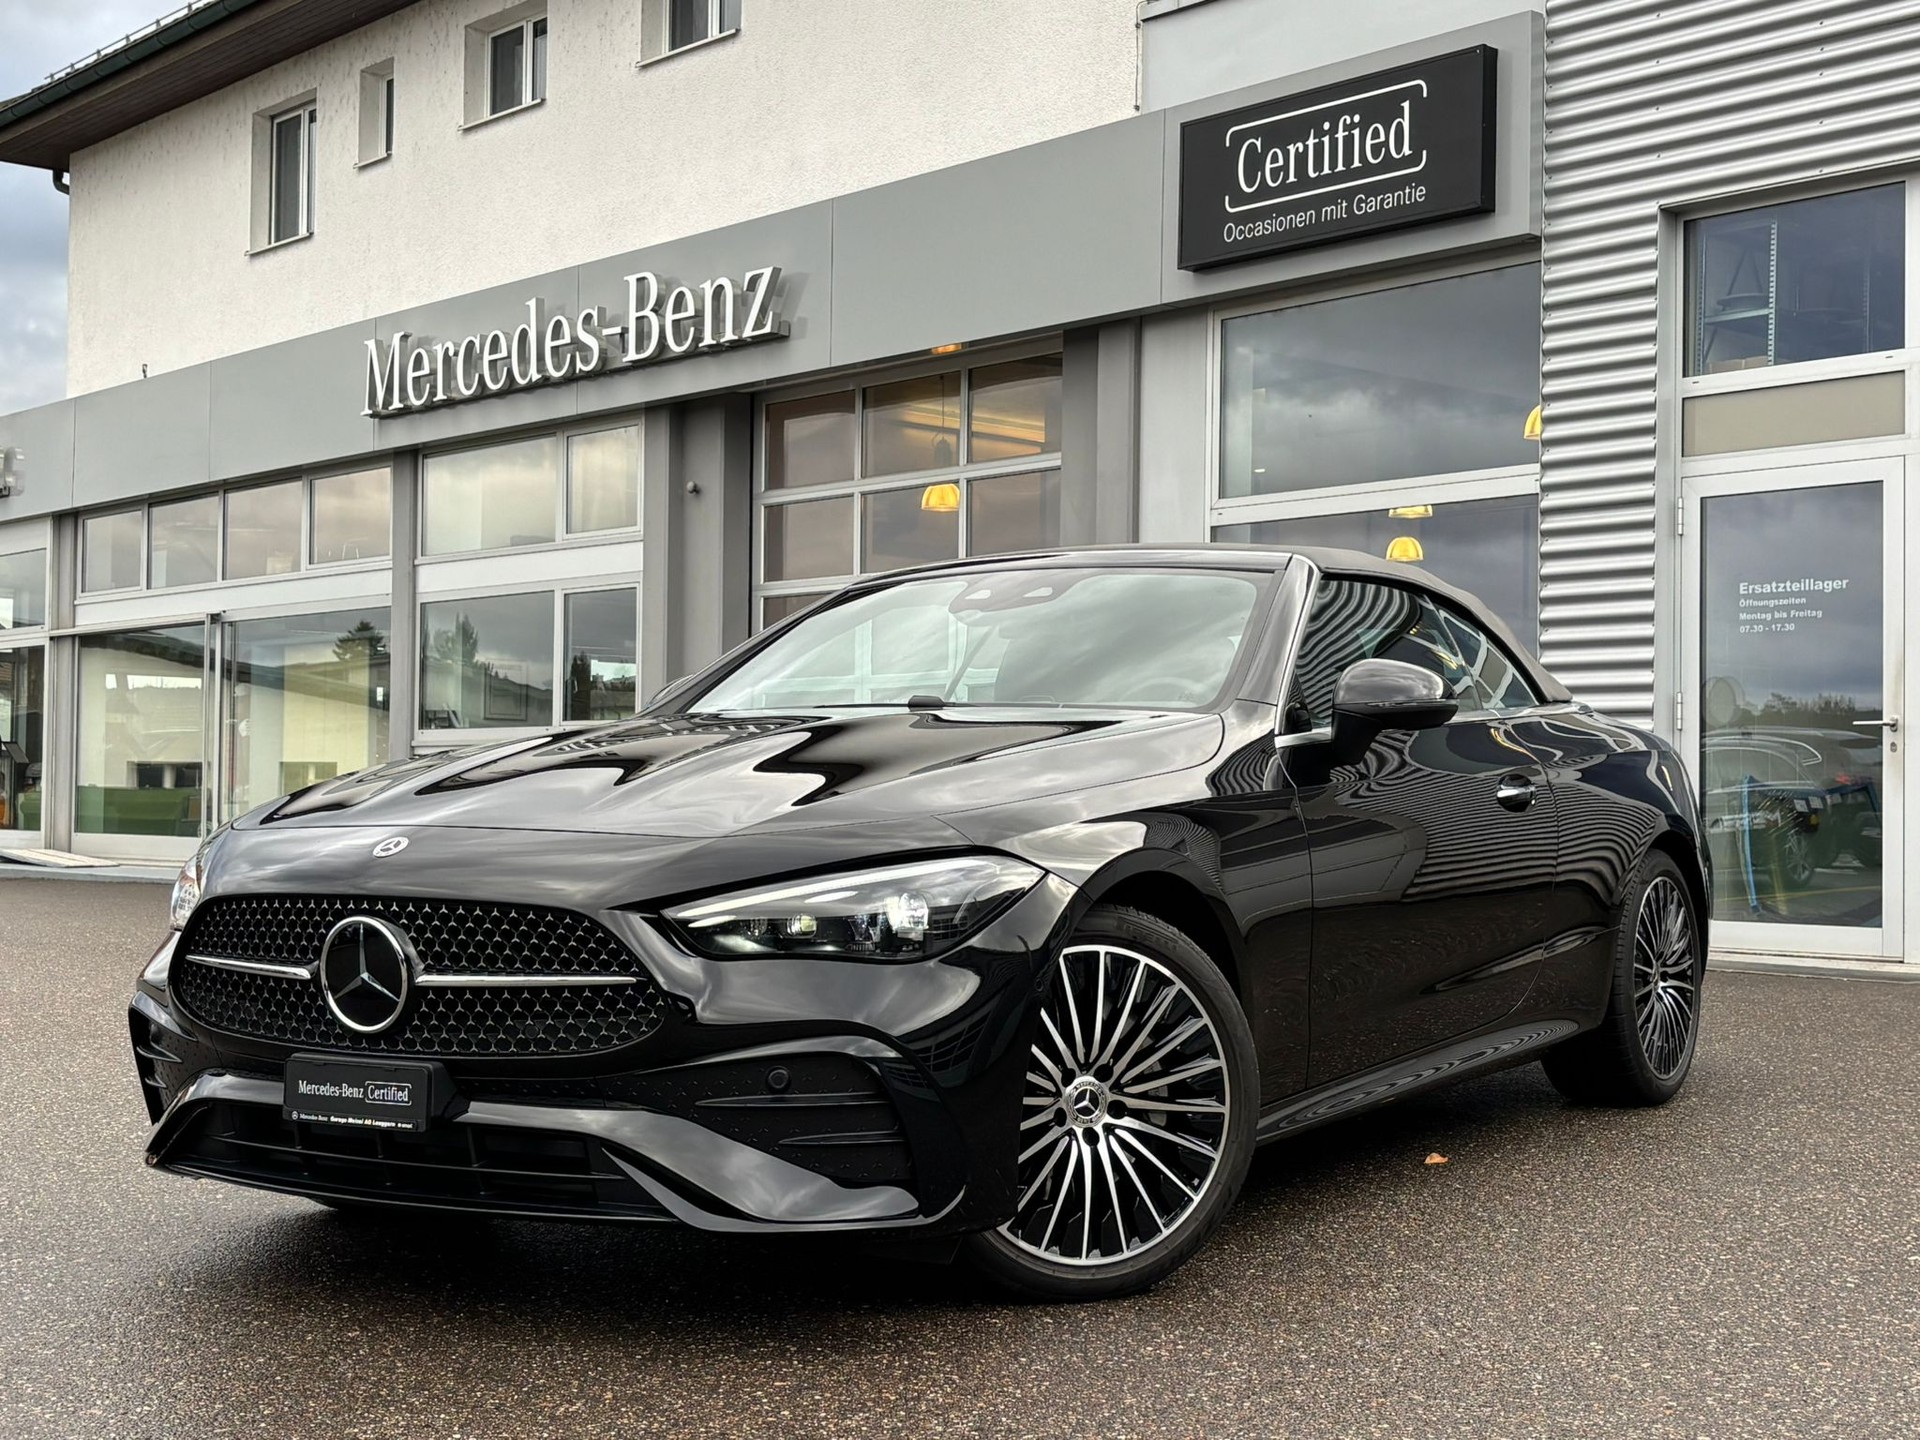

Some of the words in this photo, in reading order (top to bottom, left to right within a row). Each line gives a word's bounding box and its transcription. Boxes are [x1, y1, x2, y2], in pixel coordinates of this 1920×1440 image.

[1237, 99, 1413, 194] Certified
[1223, 209, 1316, 243] Occasionen
[1321, 201, 1348, 222] mit
[1353, 182, 1427, 215] Garantie
[360, 266, 784, 417] Mercedes-Benz
[1739, 578, 1849, 595] Ersatzteillager
[1739, 597, 1807, 608] Öffnungszeiten
[1739, 612, 1772, 621] Montag
[1774, 611, 1787, 619] bis
[1790, 609, 1822, 619] Freitag
[1739, 624, 1764, 634] 07.30
[1771, 623, 1795, 632] 17.30
[298, 1080, 364, 1098] Mercedes-Benz
[367, 1085, 409, 1101] Certified
